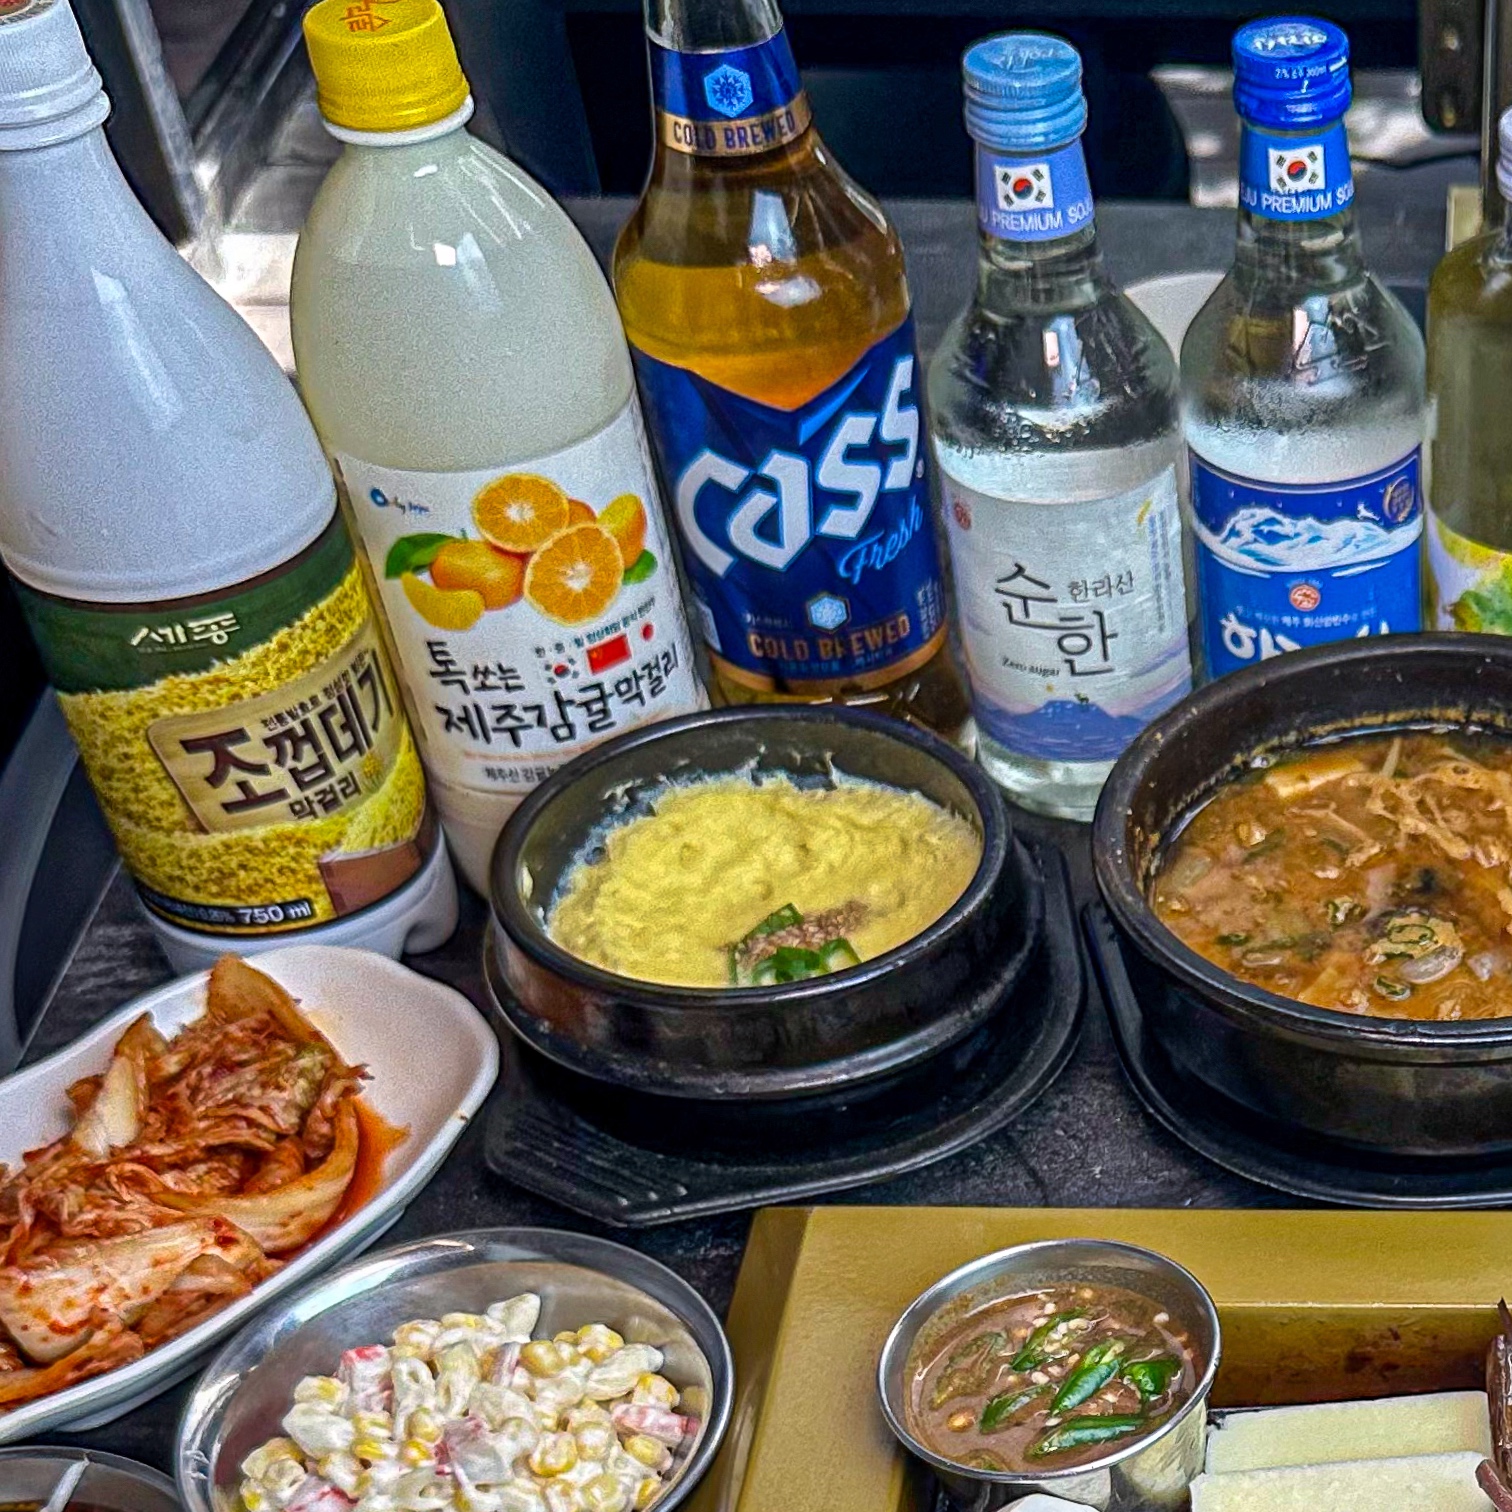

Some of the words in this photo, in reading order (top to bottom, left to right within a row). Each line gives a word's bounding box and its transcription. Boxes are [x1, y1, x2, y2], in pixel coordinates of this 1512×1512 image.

[672, 120, 716, 150] COLD
[722, 110, 796, 150] BREWED
[1261, 190, 1333, 216] PREMIUM
[990, 209, 1064, 233] PREMIUM
[836, 500, 925, 584] Fresh
[1068, 569, 1135, 600] 한라산
[747, 629, 809, 663] COLD
[180, 649, 395, 815] 조껍데기
[287, 770, 363, 823] 막걸리
[237, 904, 287, 926] 750
